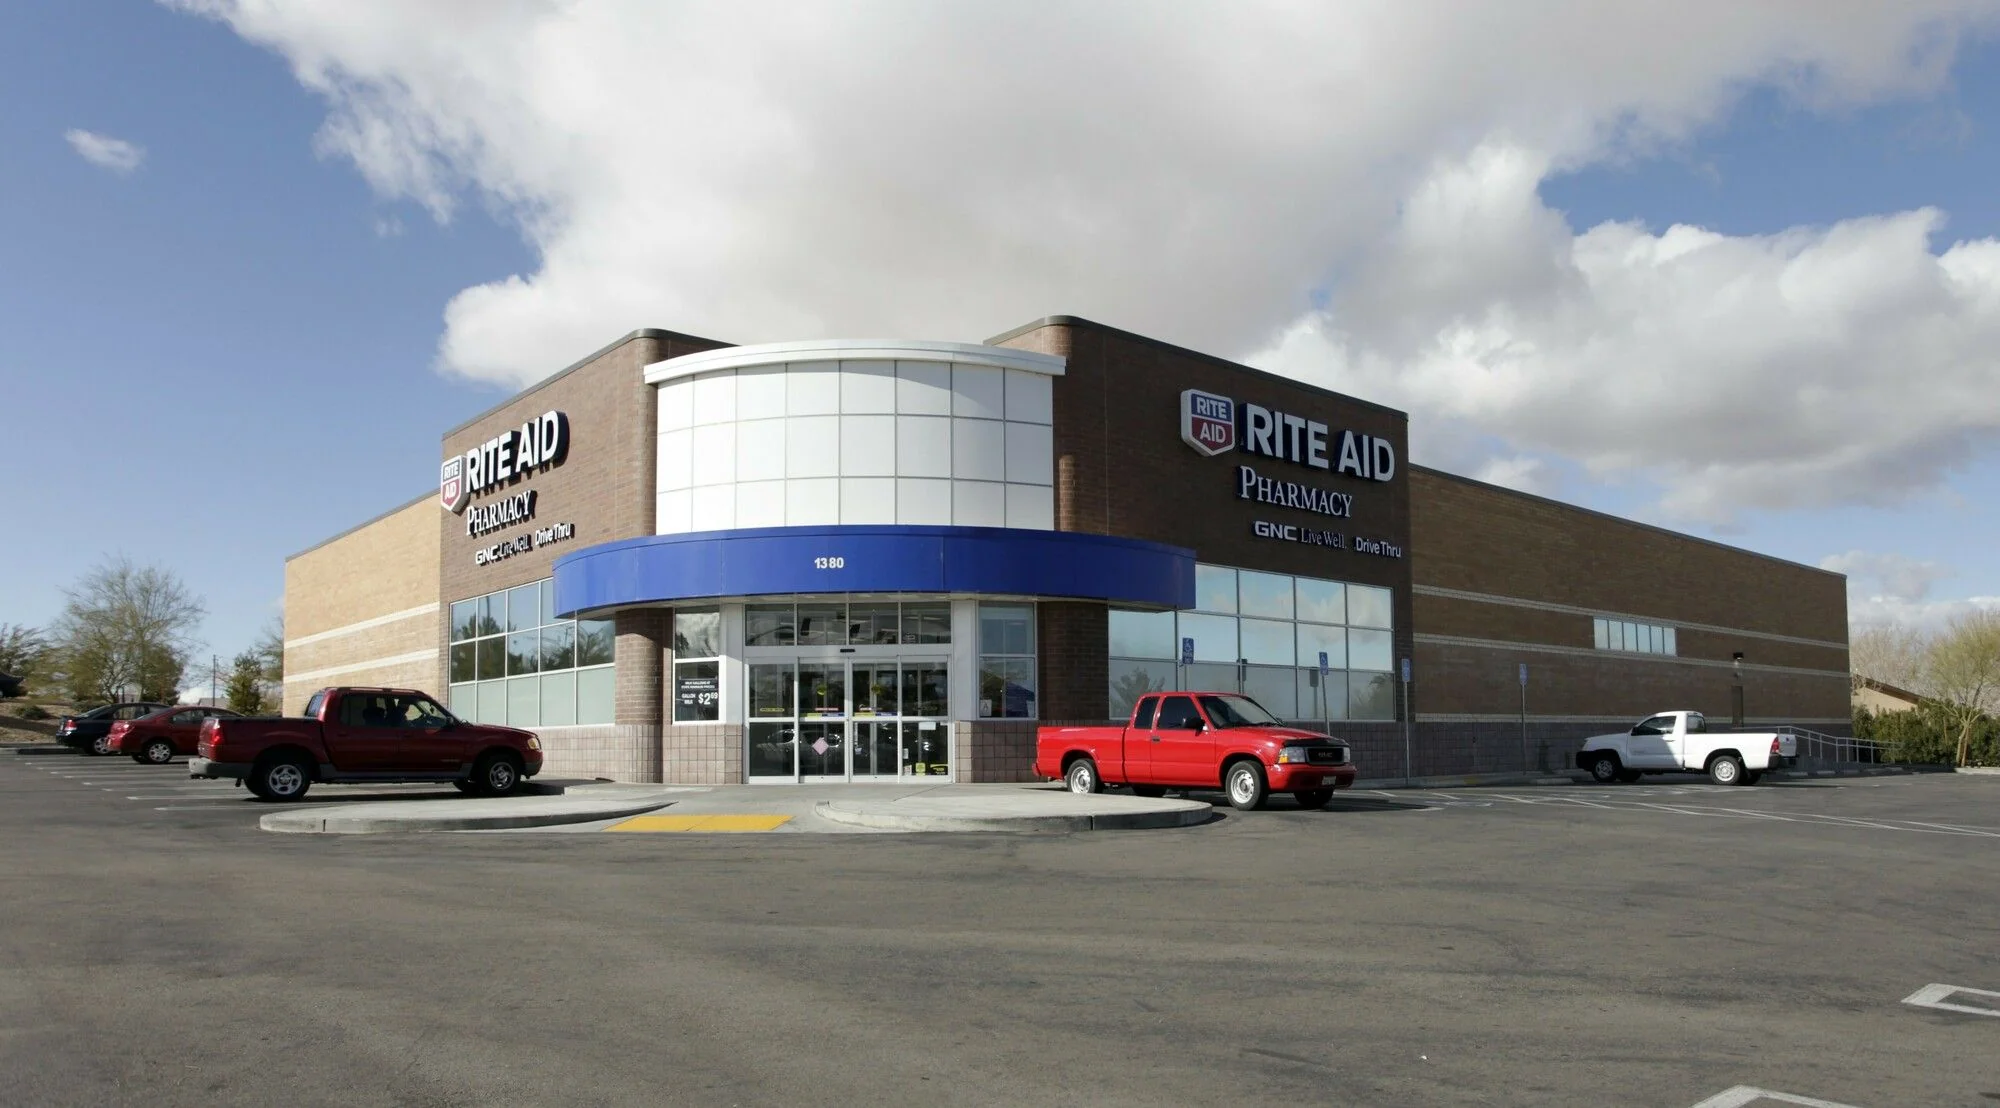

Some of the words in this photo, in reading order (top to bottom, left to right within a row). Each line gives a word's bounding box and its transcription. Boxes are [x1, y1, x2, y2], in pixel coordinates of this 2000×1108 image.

[1196, 398, 1227, 419] RITE
[1199, 421, 1226, 443] AID
[1247, 403, 1329, 470] RITE
[1338, 430, 1395, 483] AID
[443, 461, 459, 480] RITE
[466, 431, 512, 493] RITE
[515, 410, 559, 473] AID
[444, 481, 457, 500] AID
[1240, 465, 1353, 518] PHARMACY
[466, 490, 531, 536] PHARMACY
[475, 545, 498, 565] GNC
[535, 528, 553, 546] Drive
[553, 523, 570, 541] Thru
[1254, 520, 1297, 541] GNC
[1301, 527, 1322, 546] Live
[1355, 536, 1380, 555] Drive
[1380, 541, 1401, 558] Thru
[814, 557, 844, 569] 1380
